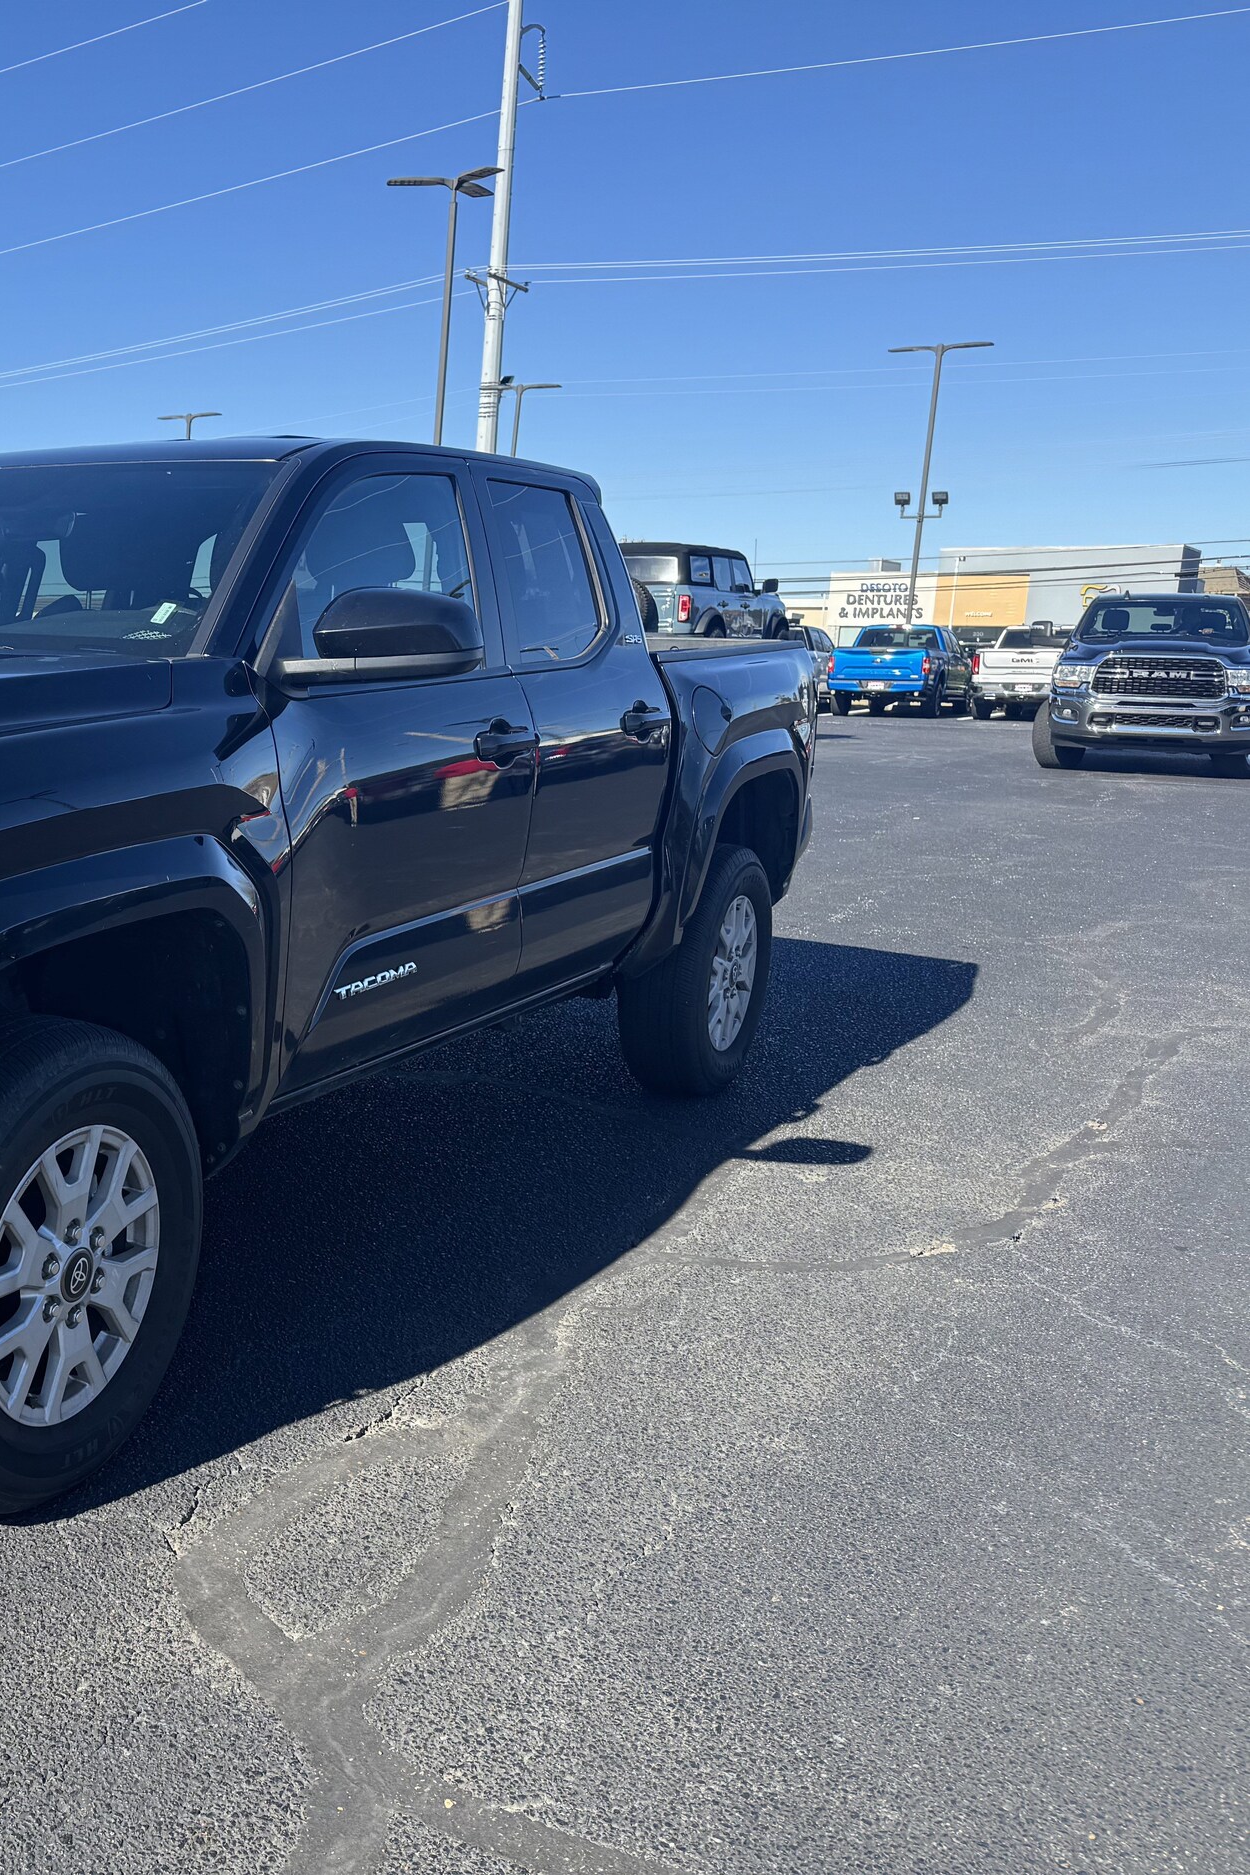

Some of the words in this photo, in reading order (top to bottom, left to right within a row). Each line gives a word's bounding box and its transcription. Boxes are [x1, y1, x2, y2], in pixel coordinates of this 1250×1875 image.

[860, 582, 908, 593] DESOTO
[846, 593, 919, 605] DENTURES
[838, 607, 849, 618] &
[1132, 670, 1187, 679] RAM
[333, 961, 418, 1000] TACOMA
